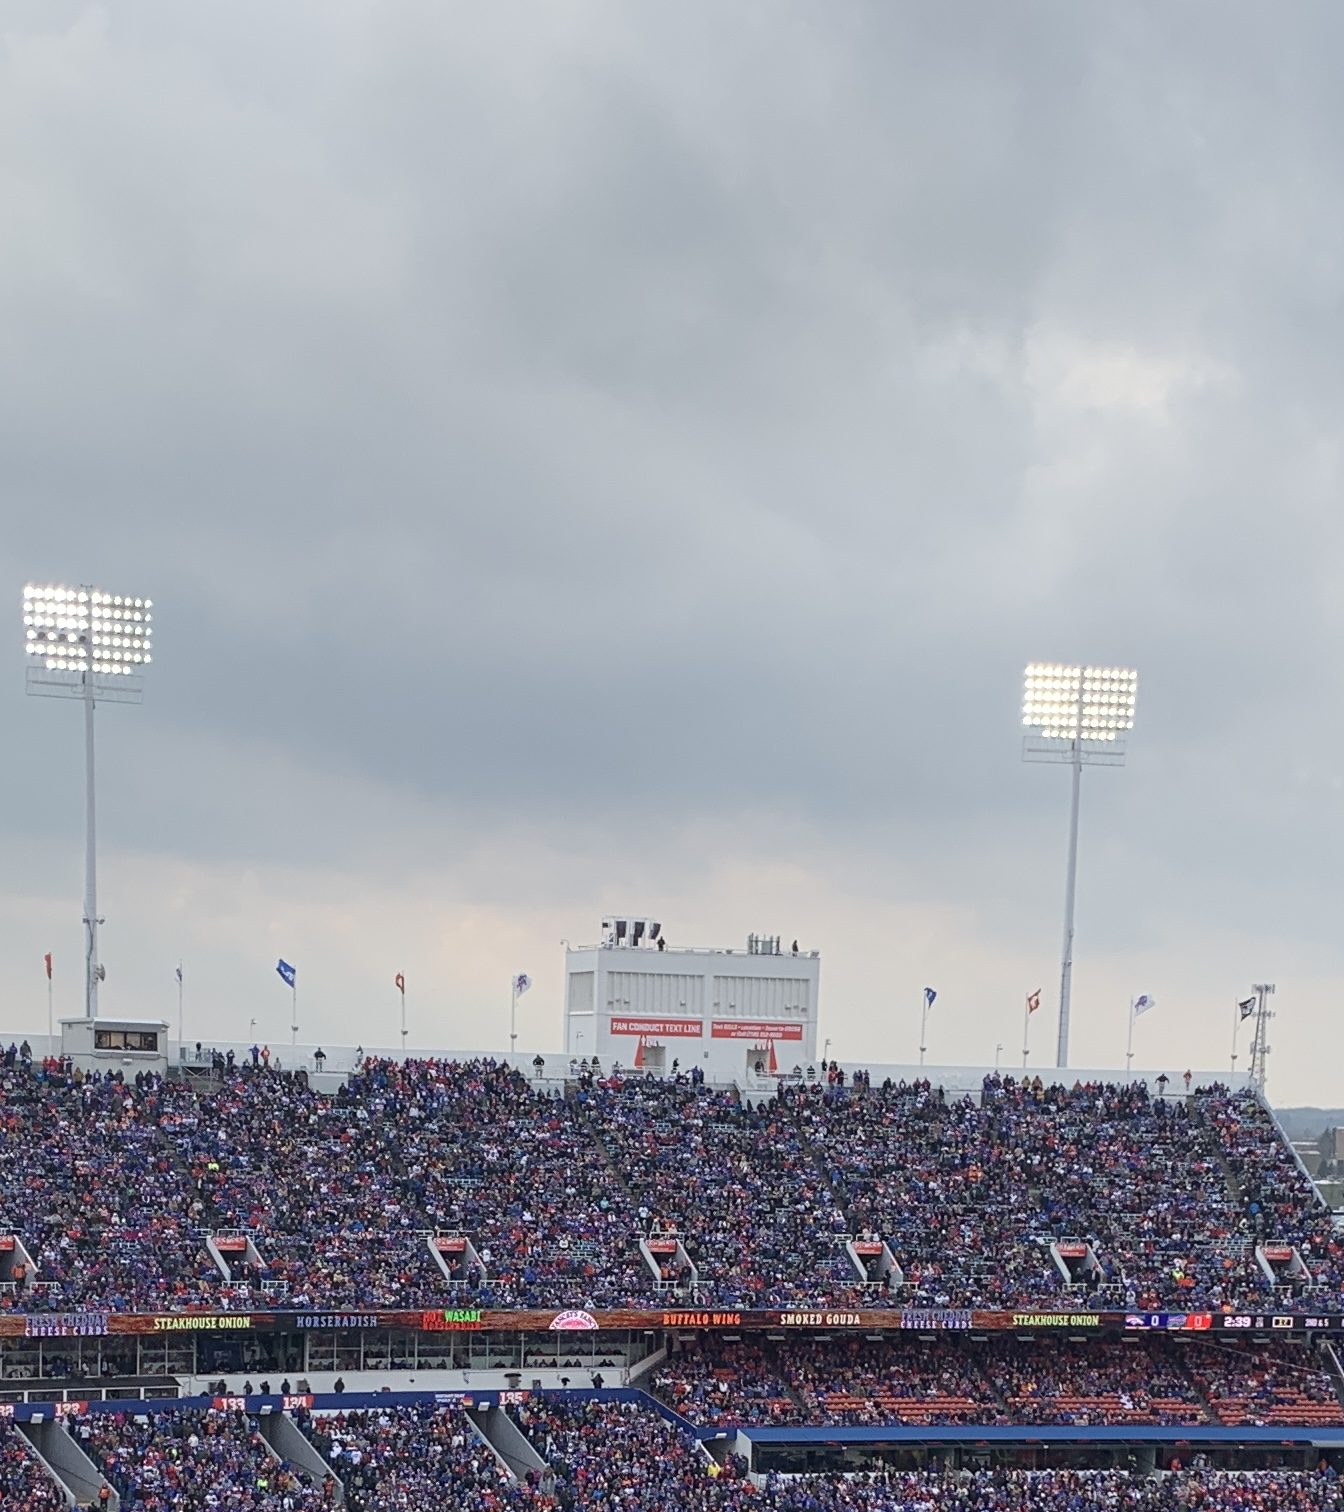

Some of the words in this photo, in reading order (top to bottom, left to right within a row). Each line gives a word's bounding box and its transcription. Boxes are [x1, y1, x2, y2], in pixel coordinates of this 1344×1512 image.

[613, 1022, 628, 1031] FAN
[629, 1023, 662, 1032] CONDUCT
[665, 1024, 682, 1032] TEXT
[684, 1025, 701, 1033] LINE
[61, 1313, 109, 1326] CHEDDAR
[296, 1315, 377, 1329] HORSERADISH
[444, 1310, 482, 1323] WASABI
[663, 1313, 708, 1326] BUFFALO
[712, 1313, 741, 1326] WING
[780, 1313, 822, 1326] SMOKED
[826, 1313, 860, 1326] GOUDA
[1013, 1314, 1070, 1327] STEAKHOUSE
[1072, 1314, 1099, 1327] ONION
[1151, 1315, 1159, 1327] 0
[1194, 1316, 1203, 1328] 0
[1224, 1316, 1251, 1328] 2:39
[154, 1317, 217, 1331] STEAKHOUSE
[219, 1316, 250, 1330] ONION
[25, 1326, 67, 1337] CHEESE
[72, 1325, 109, 1336] CURDS
[221, 1397, 245, 1411] 133
[500, 1391, 523, 1405] 135
